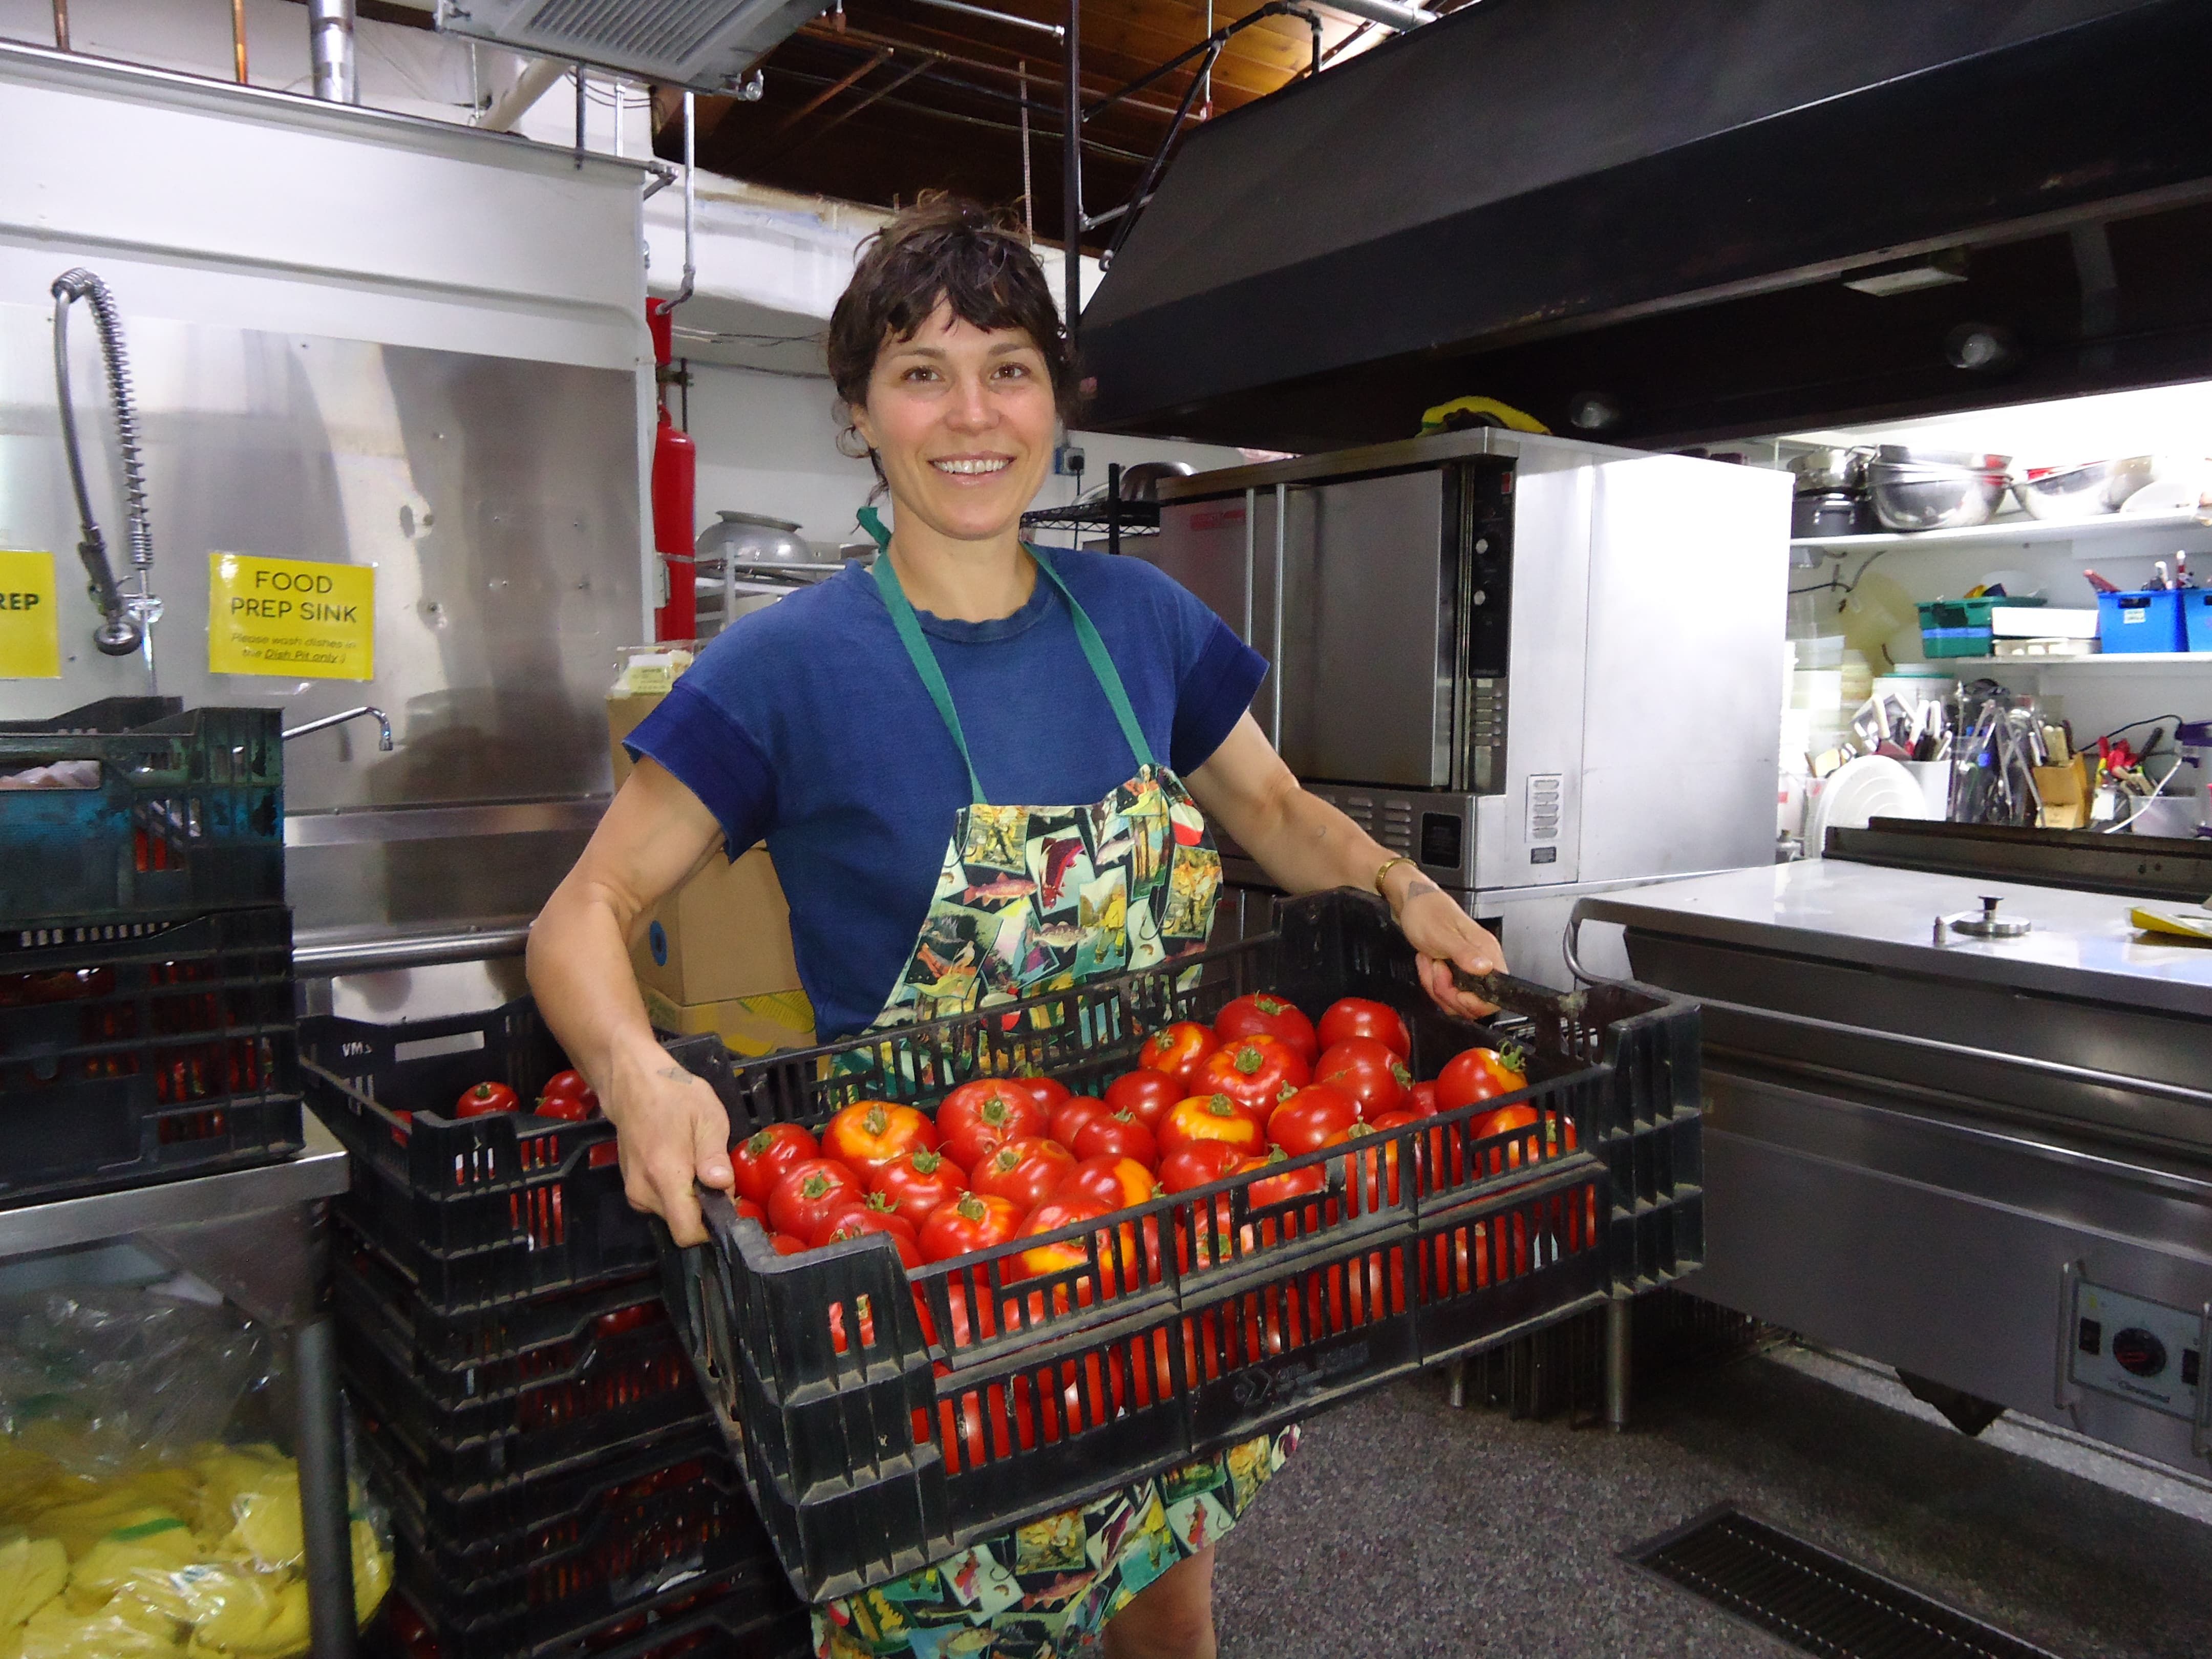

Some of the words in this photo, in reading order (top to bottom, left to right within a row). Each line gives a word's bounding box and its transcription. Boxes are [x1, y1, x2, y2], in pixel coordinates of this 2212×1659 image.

[256, 570, 333, 593] FOOD
[230, 597, 292, 618] PREP
[300, 602, 357, 623] SINK
[231, 632, 269, 644] Please
[272, 636, 302, 646] wash
[305, 638, 343, 649] dishes
[264, 648, 292, 660] Dish
[294, 650, 309, 661] Pit
